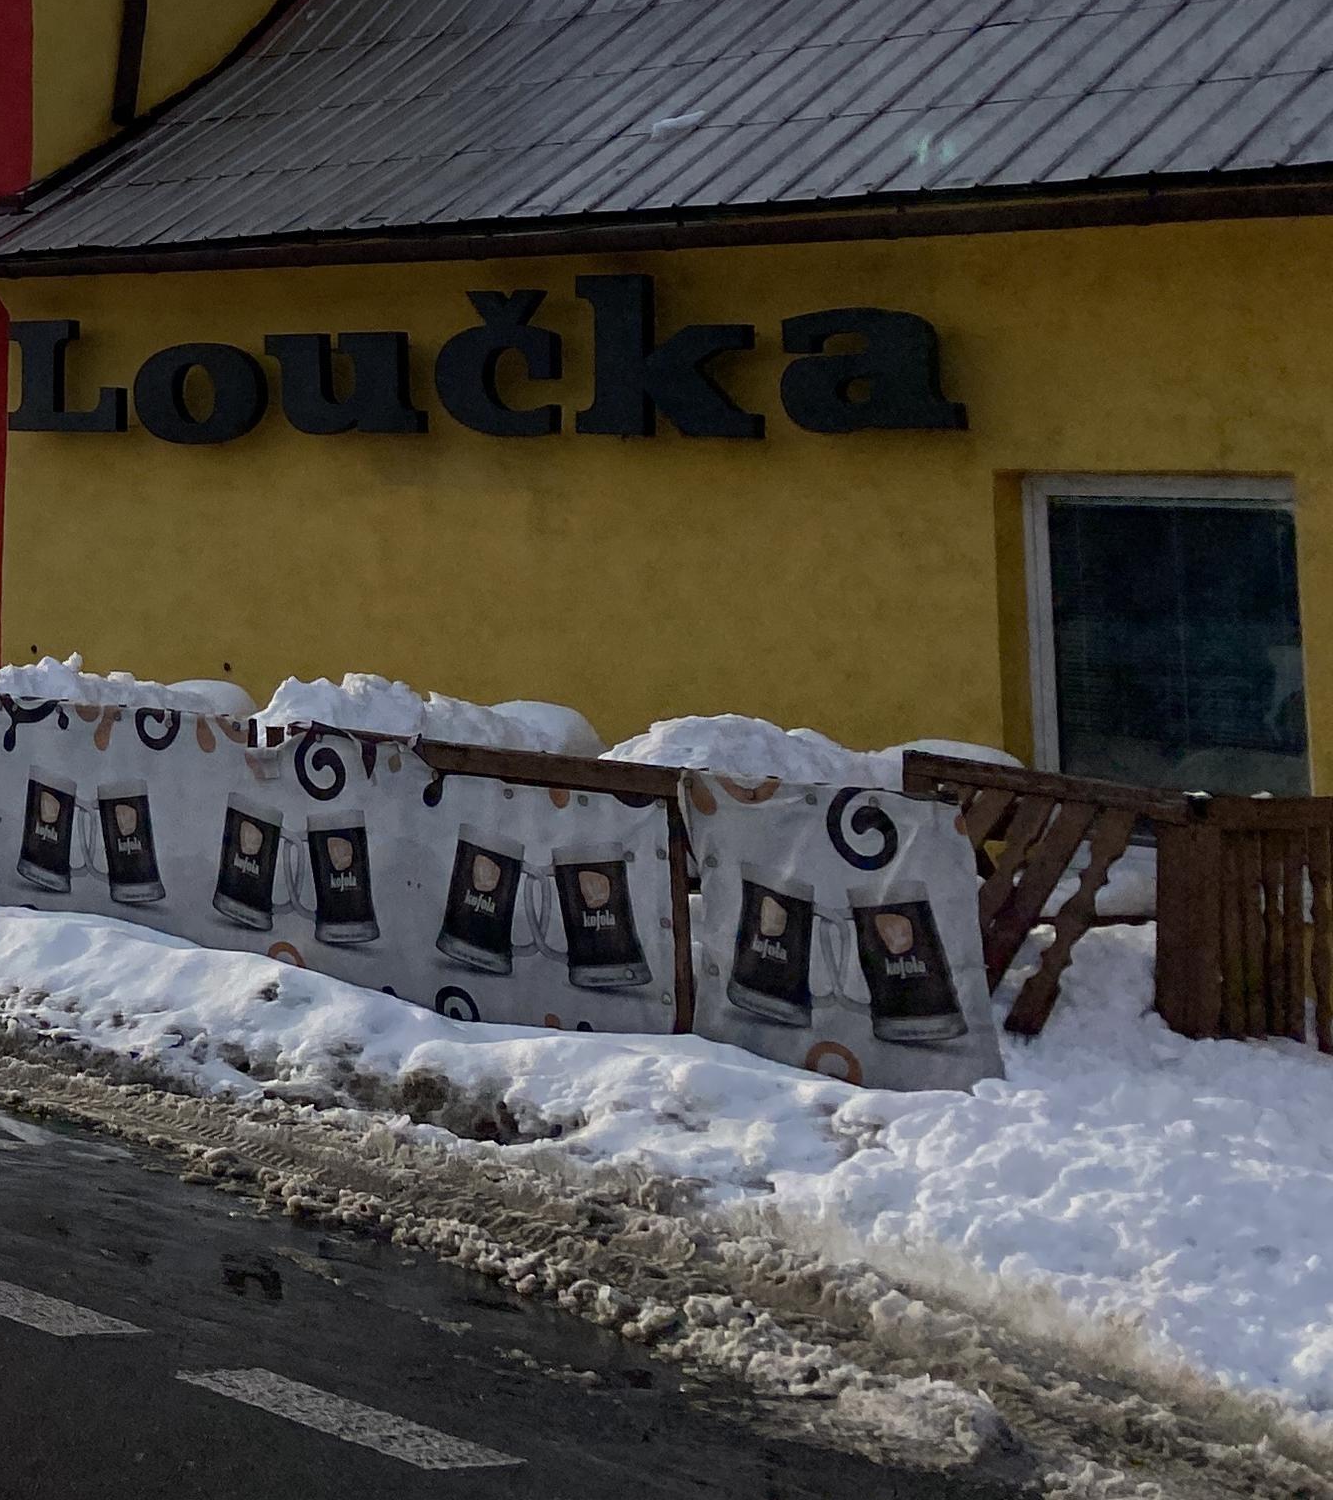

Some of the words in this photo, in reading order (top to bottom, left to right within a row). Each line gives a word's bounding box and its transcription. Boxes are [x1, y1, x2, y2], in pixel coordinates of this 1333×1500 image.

[8, 272, 969, 444] Loučka
[463, 888, 496, 914] kofola
[583, 909, 617, 932] kofola
